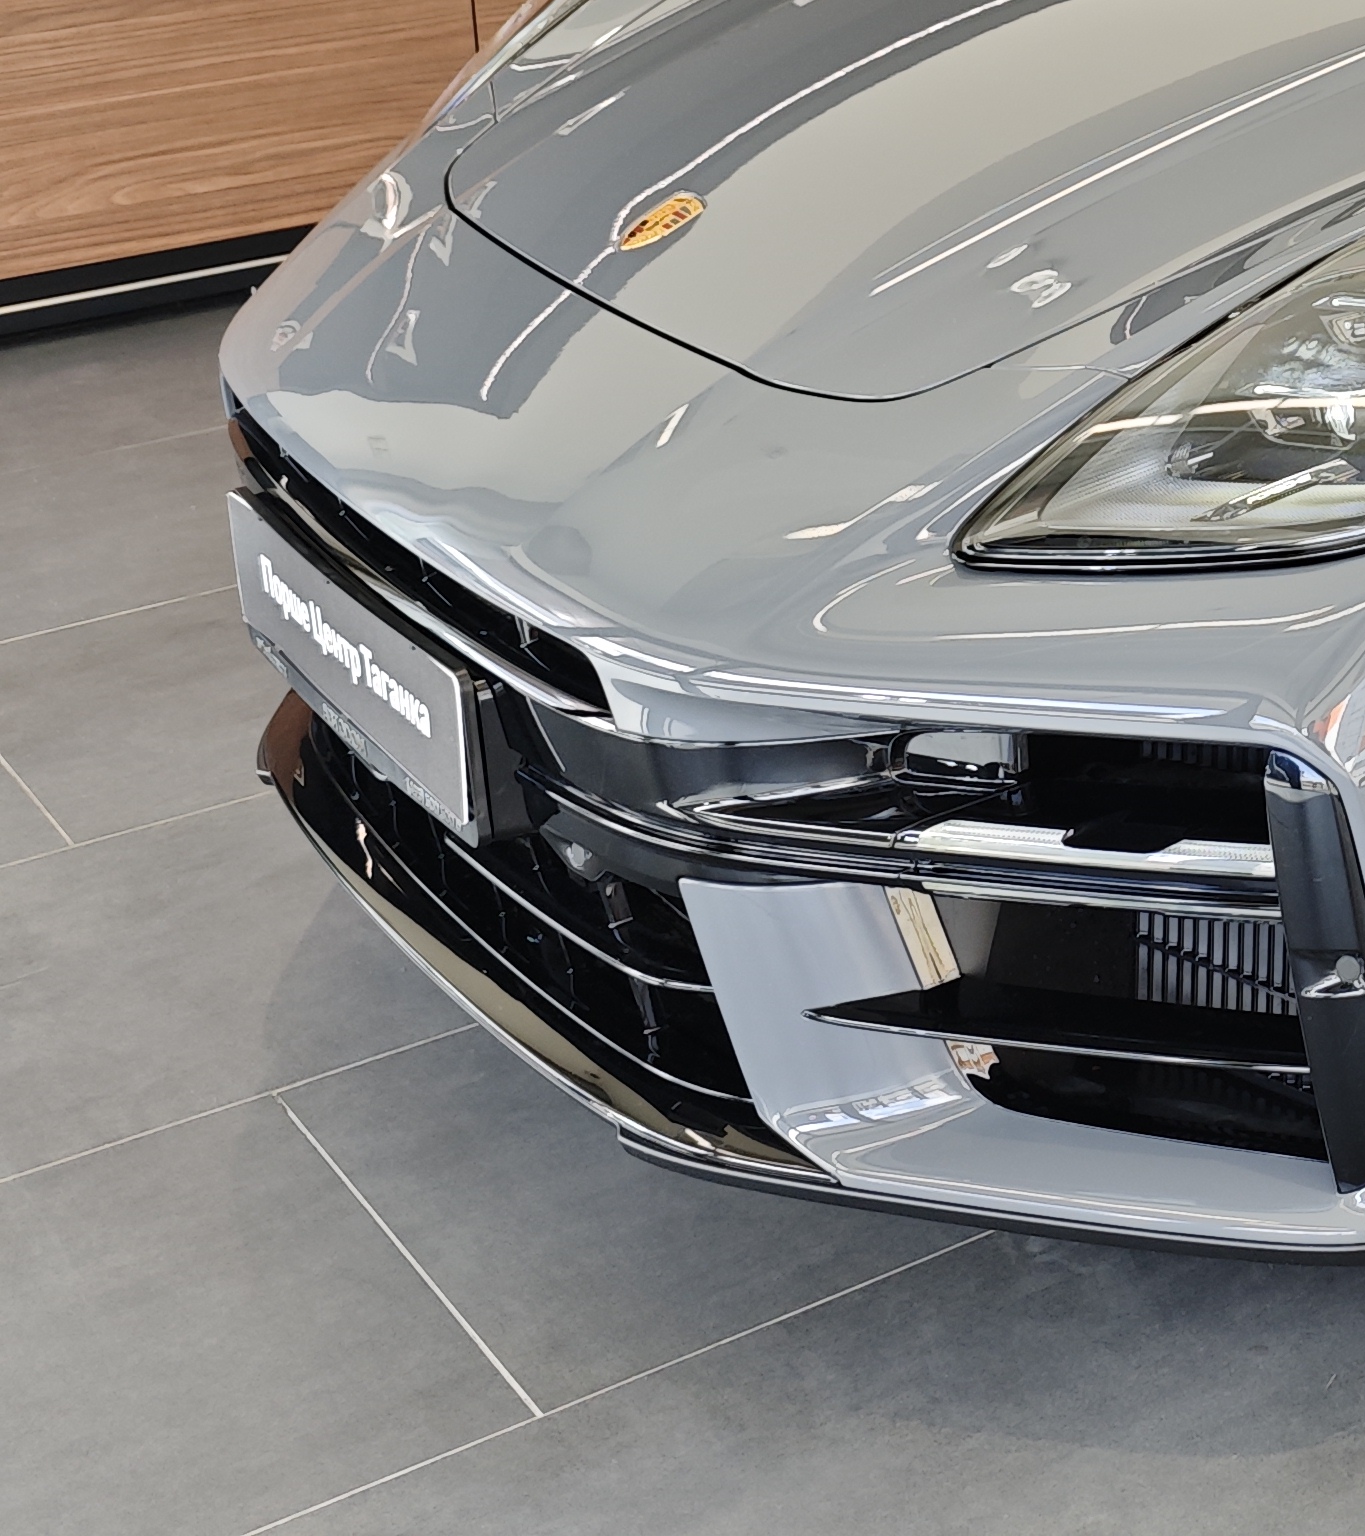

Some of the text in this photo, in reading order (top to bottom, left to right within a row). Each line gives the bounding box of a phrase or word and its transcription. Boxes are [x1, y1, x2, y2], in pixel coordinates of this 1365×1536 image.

[258, 553, 311, 633] Порше
[308, 600, 362, 686] Центр
[358, 643, 432, 739] Таганка
